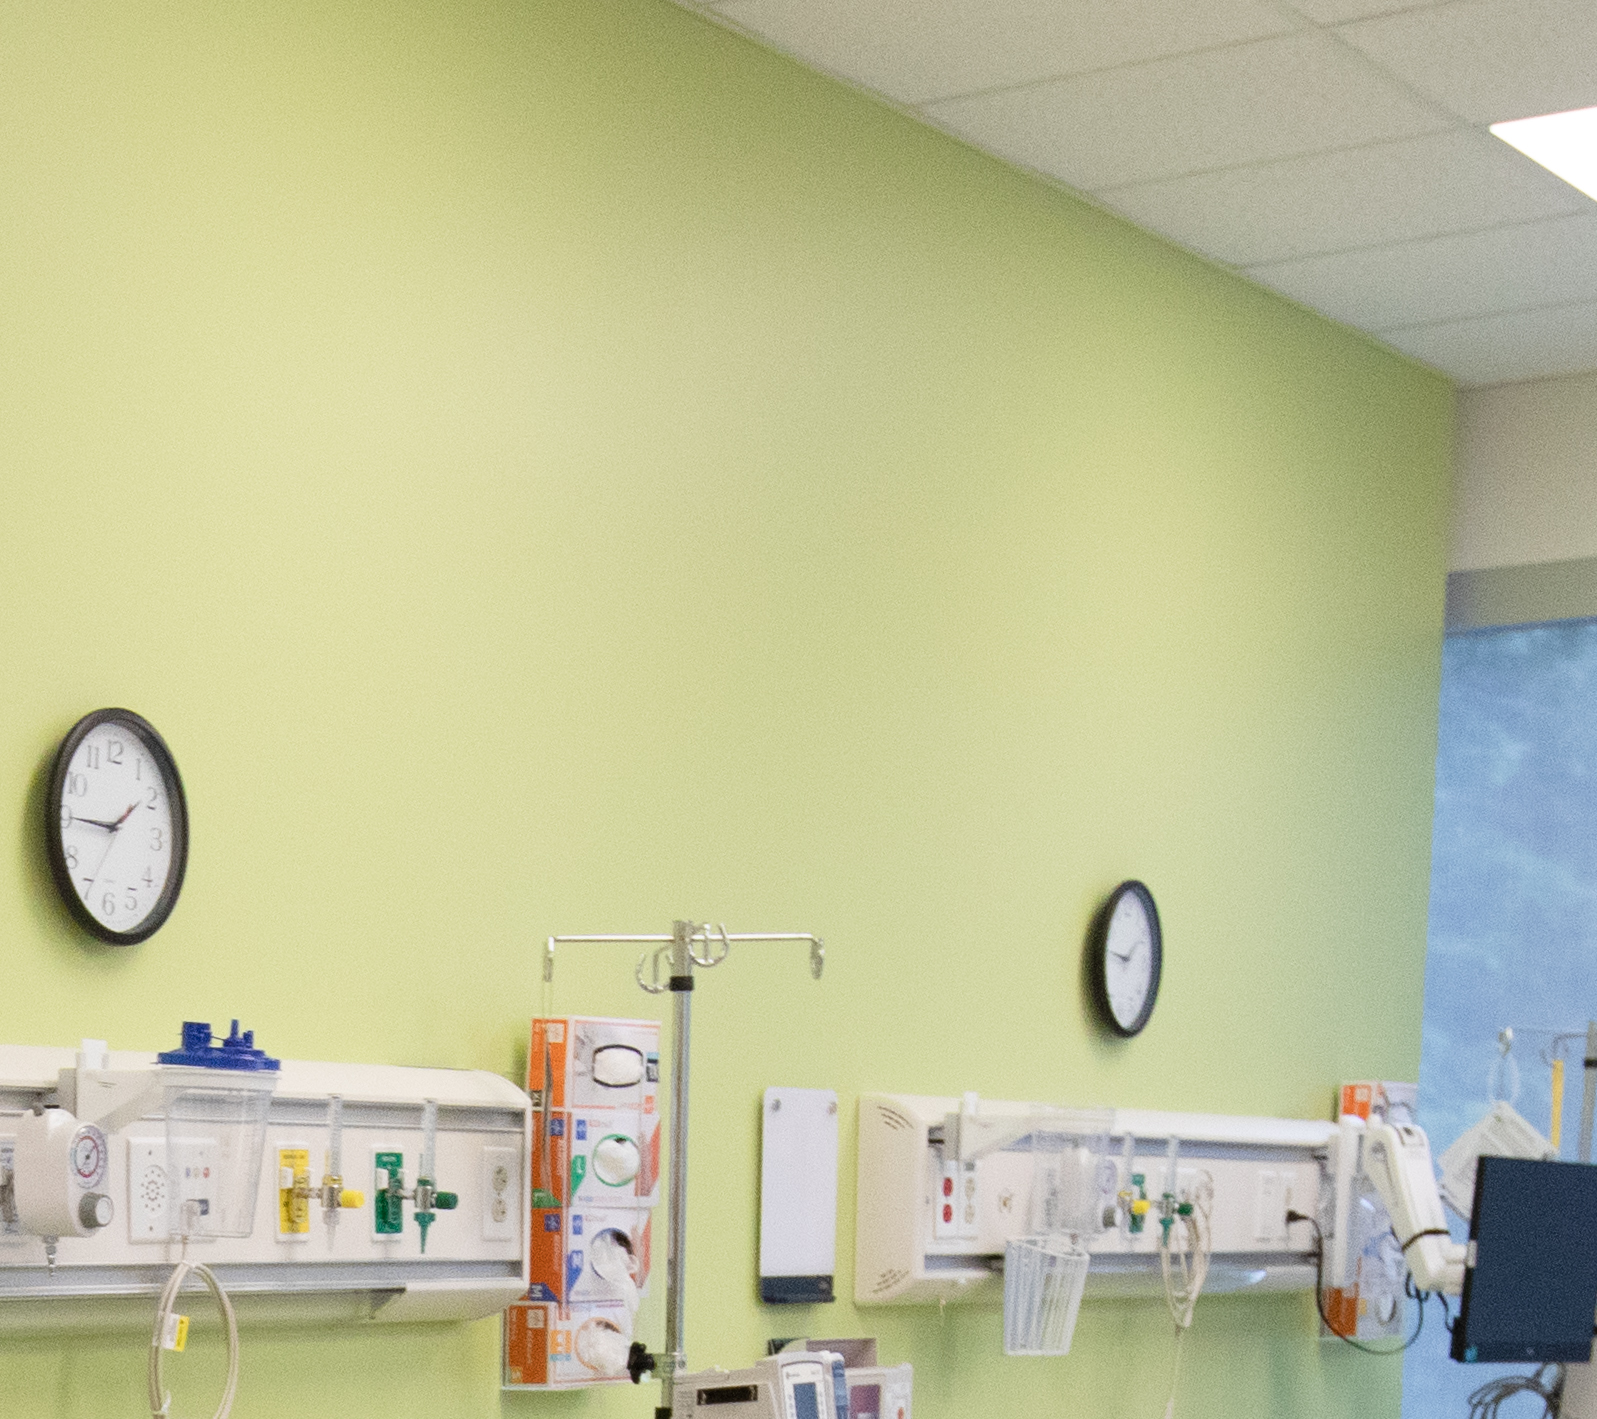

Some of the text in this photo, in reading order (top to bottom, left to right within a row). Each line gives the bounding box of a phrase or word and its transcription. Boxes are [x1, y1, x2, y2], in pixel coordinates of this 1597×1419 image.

[86, 745, 100, 770] 11
[106, 739, 124, 765] 12
[135, 757, 142, 781] 1
[67, 770, 88, 797] 10
[147, 786, 158, 810] 2
[61, 804, 73, 829] 9
[150, 827, 164, 851] 3
[65, 845, 79, 869] 8
[82, 877, 95, 901] 7
[142, 866, 154, 889] 4
[102, 892, 115, 916] 6
[125, 886, 138, 911] 5
